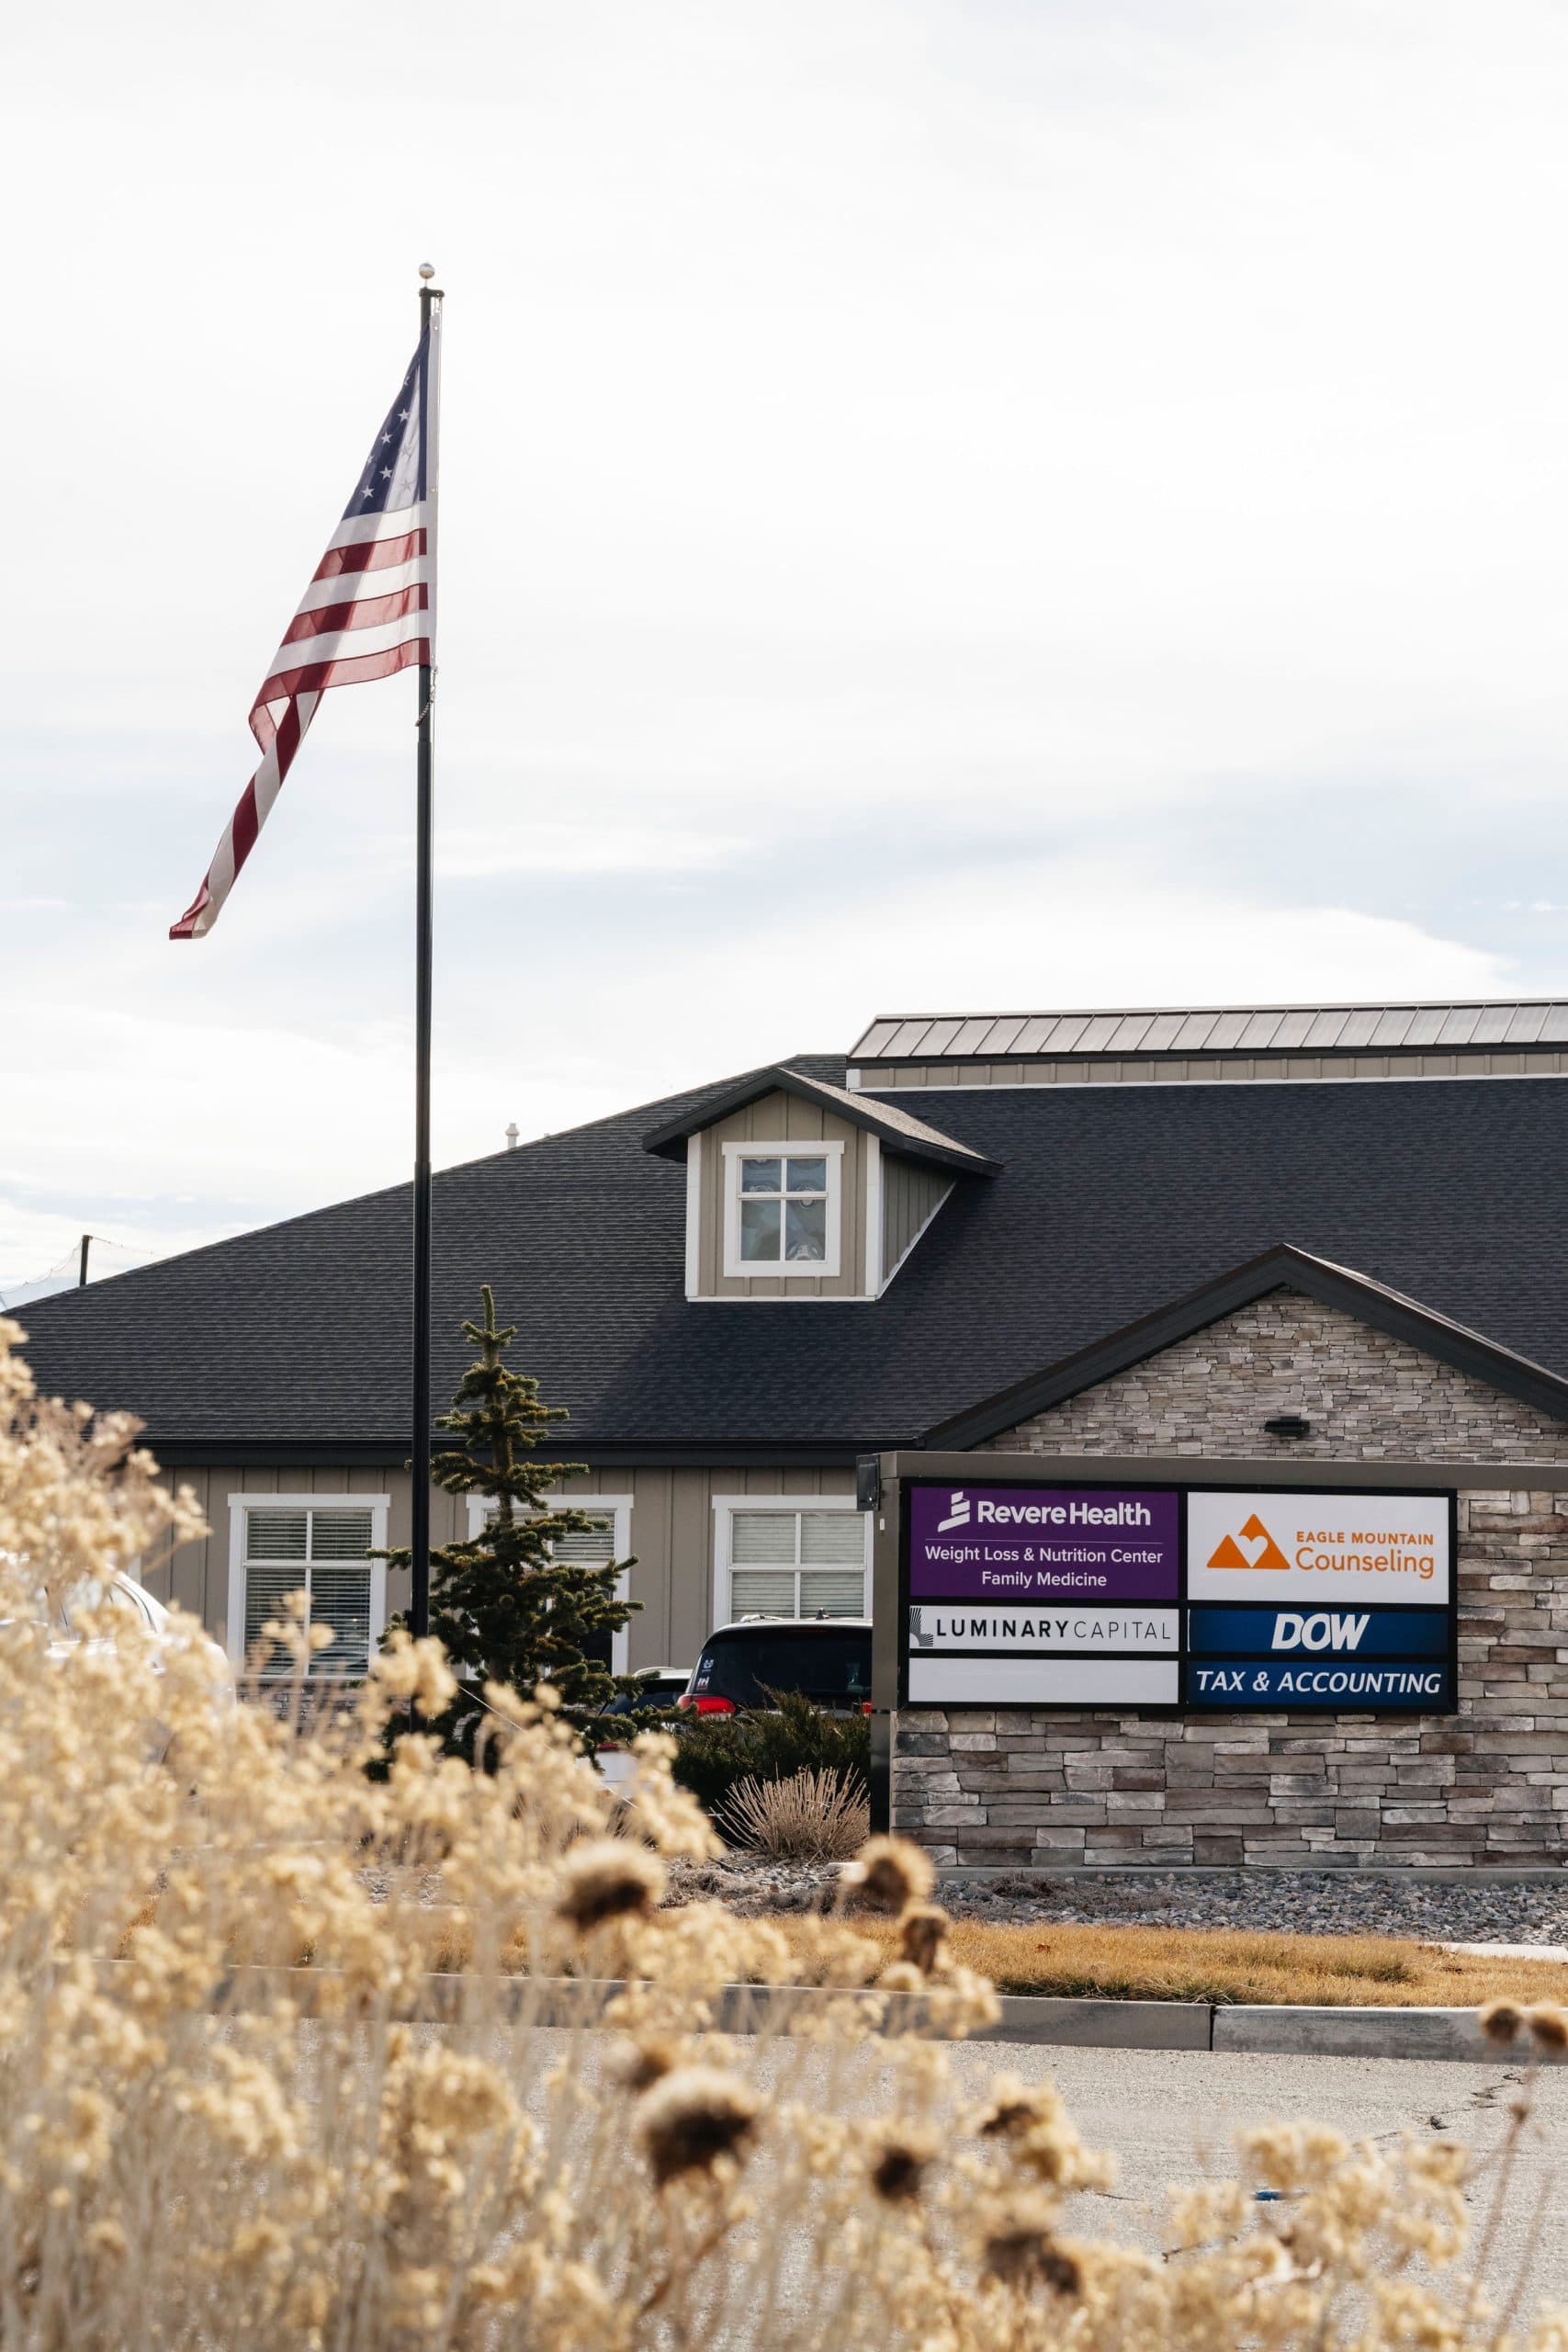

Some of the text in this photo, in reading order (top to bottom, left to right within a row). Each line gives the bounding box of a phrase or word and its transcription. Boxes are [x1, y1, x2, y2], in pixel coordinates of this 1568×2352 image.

[977, 1500, 1151, 1526] Revere Health
[1296, 1531, 1434, 1545] EAGLE MOUNTAIN
[925, 1545, 1163, 1564] Weight Loss & Nutrition Center
[1295, 1547, 1434, 1579] Counseling
[982, 1571, 1107, 1589] Family Medicine
[1271, 1613, 1371, 1651] DOW
[1196, 1671, 1441, 1693] TAX & ACCOUNTING
